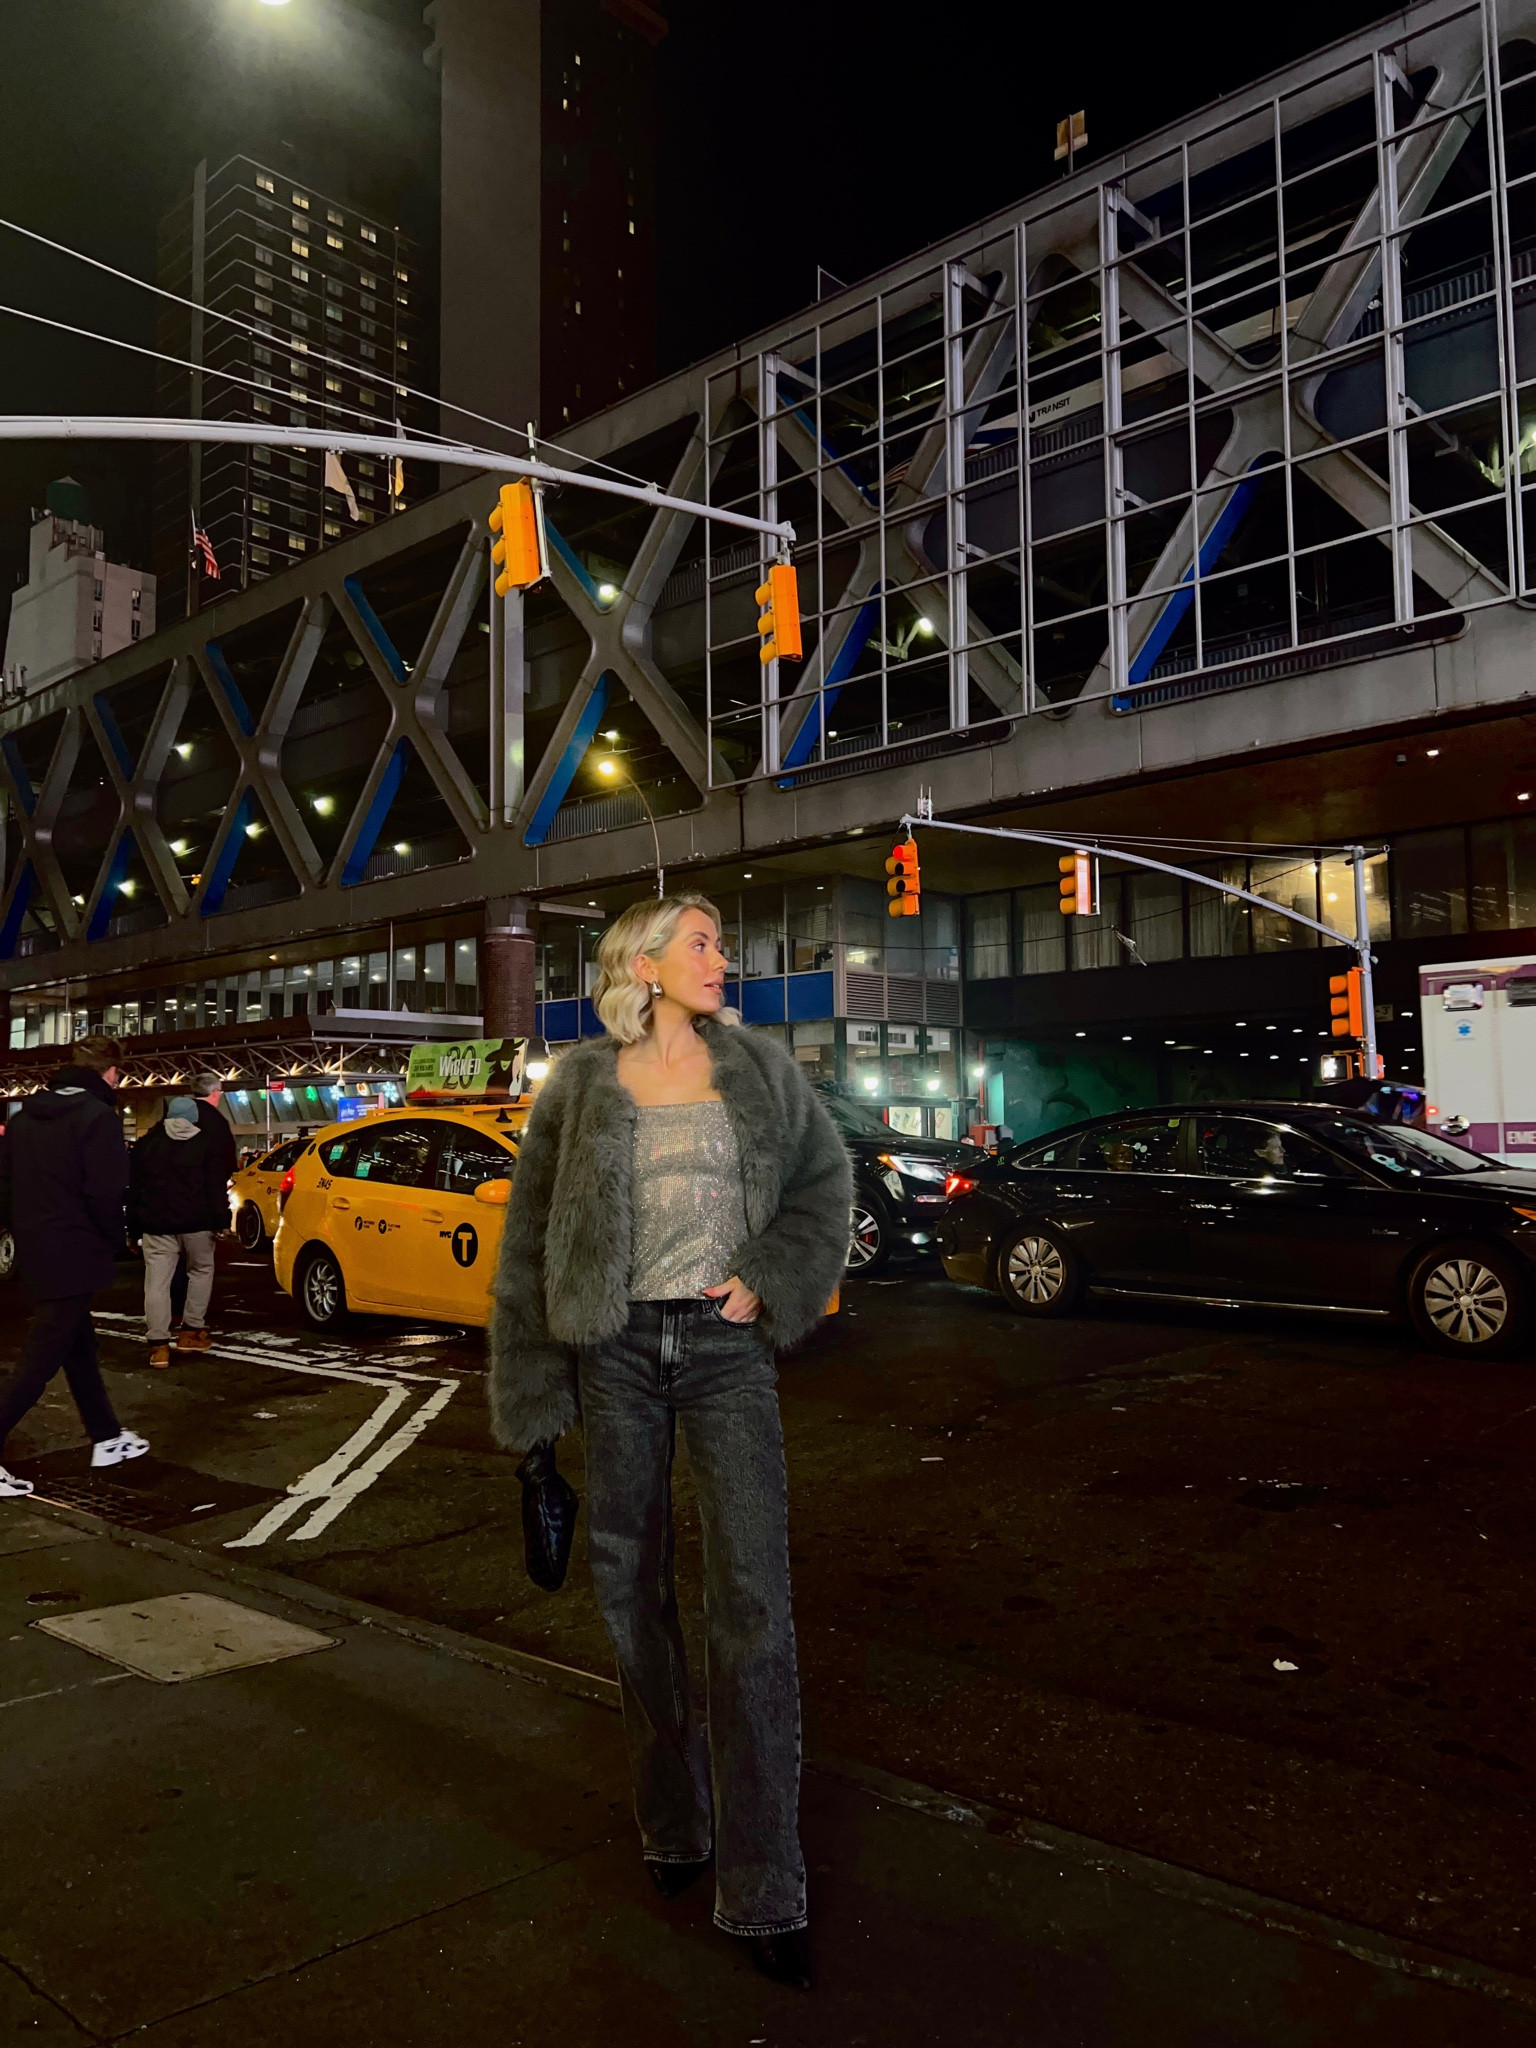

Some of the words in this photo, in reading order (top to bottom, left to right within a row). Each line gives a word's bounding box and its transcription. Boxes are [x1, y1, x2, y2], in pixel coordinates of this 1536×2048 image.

[1036, 397, 1071, 417] TRANSIT
[439, 1230, 452, 1239] NYC
[457, 1231, 473, 1262] T
